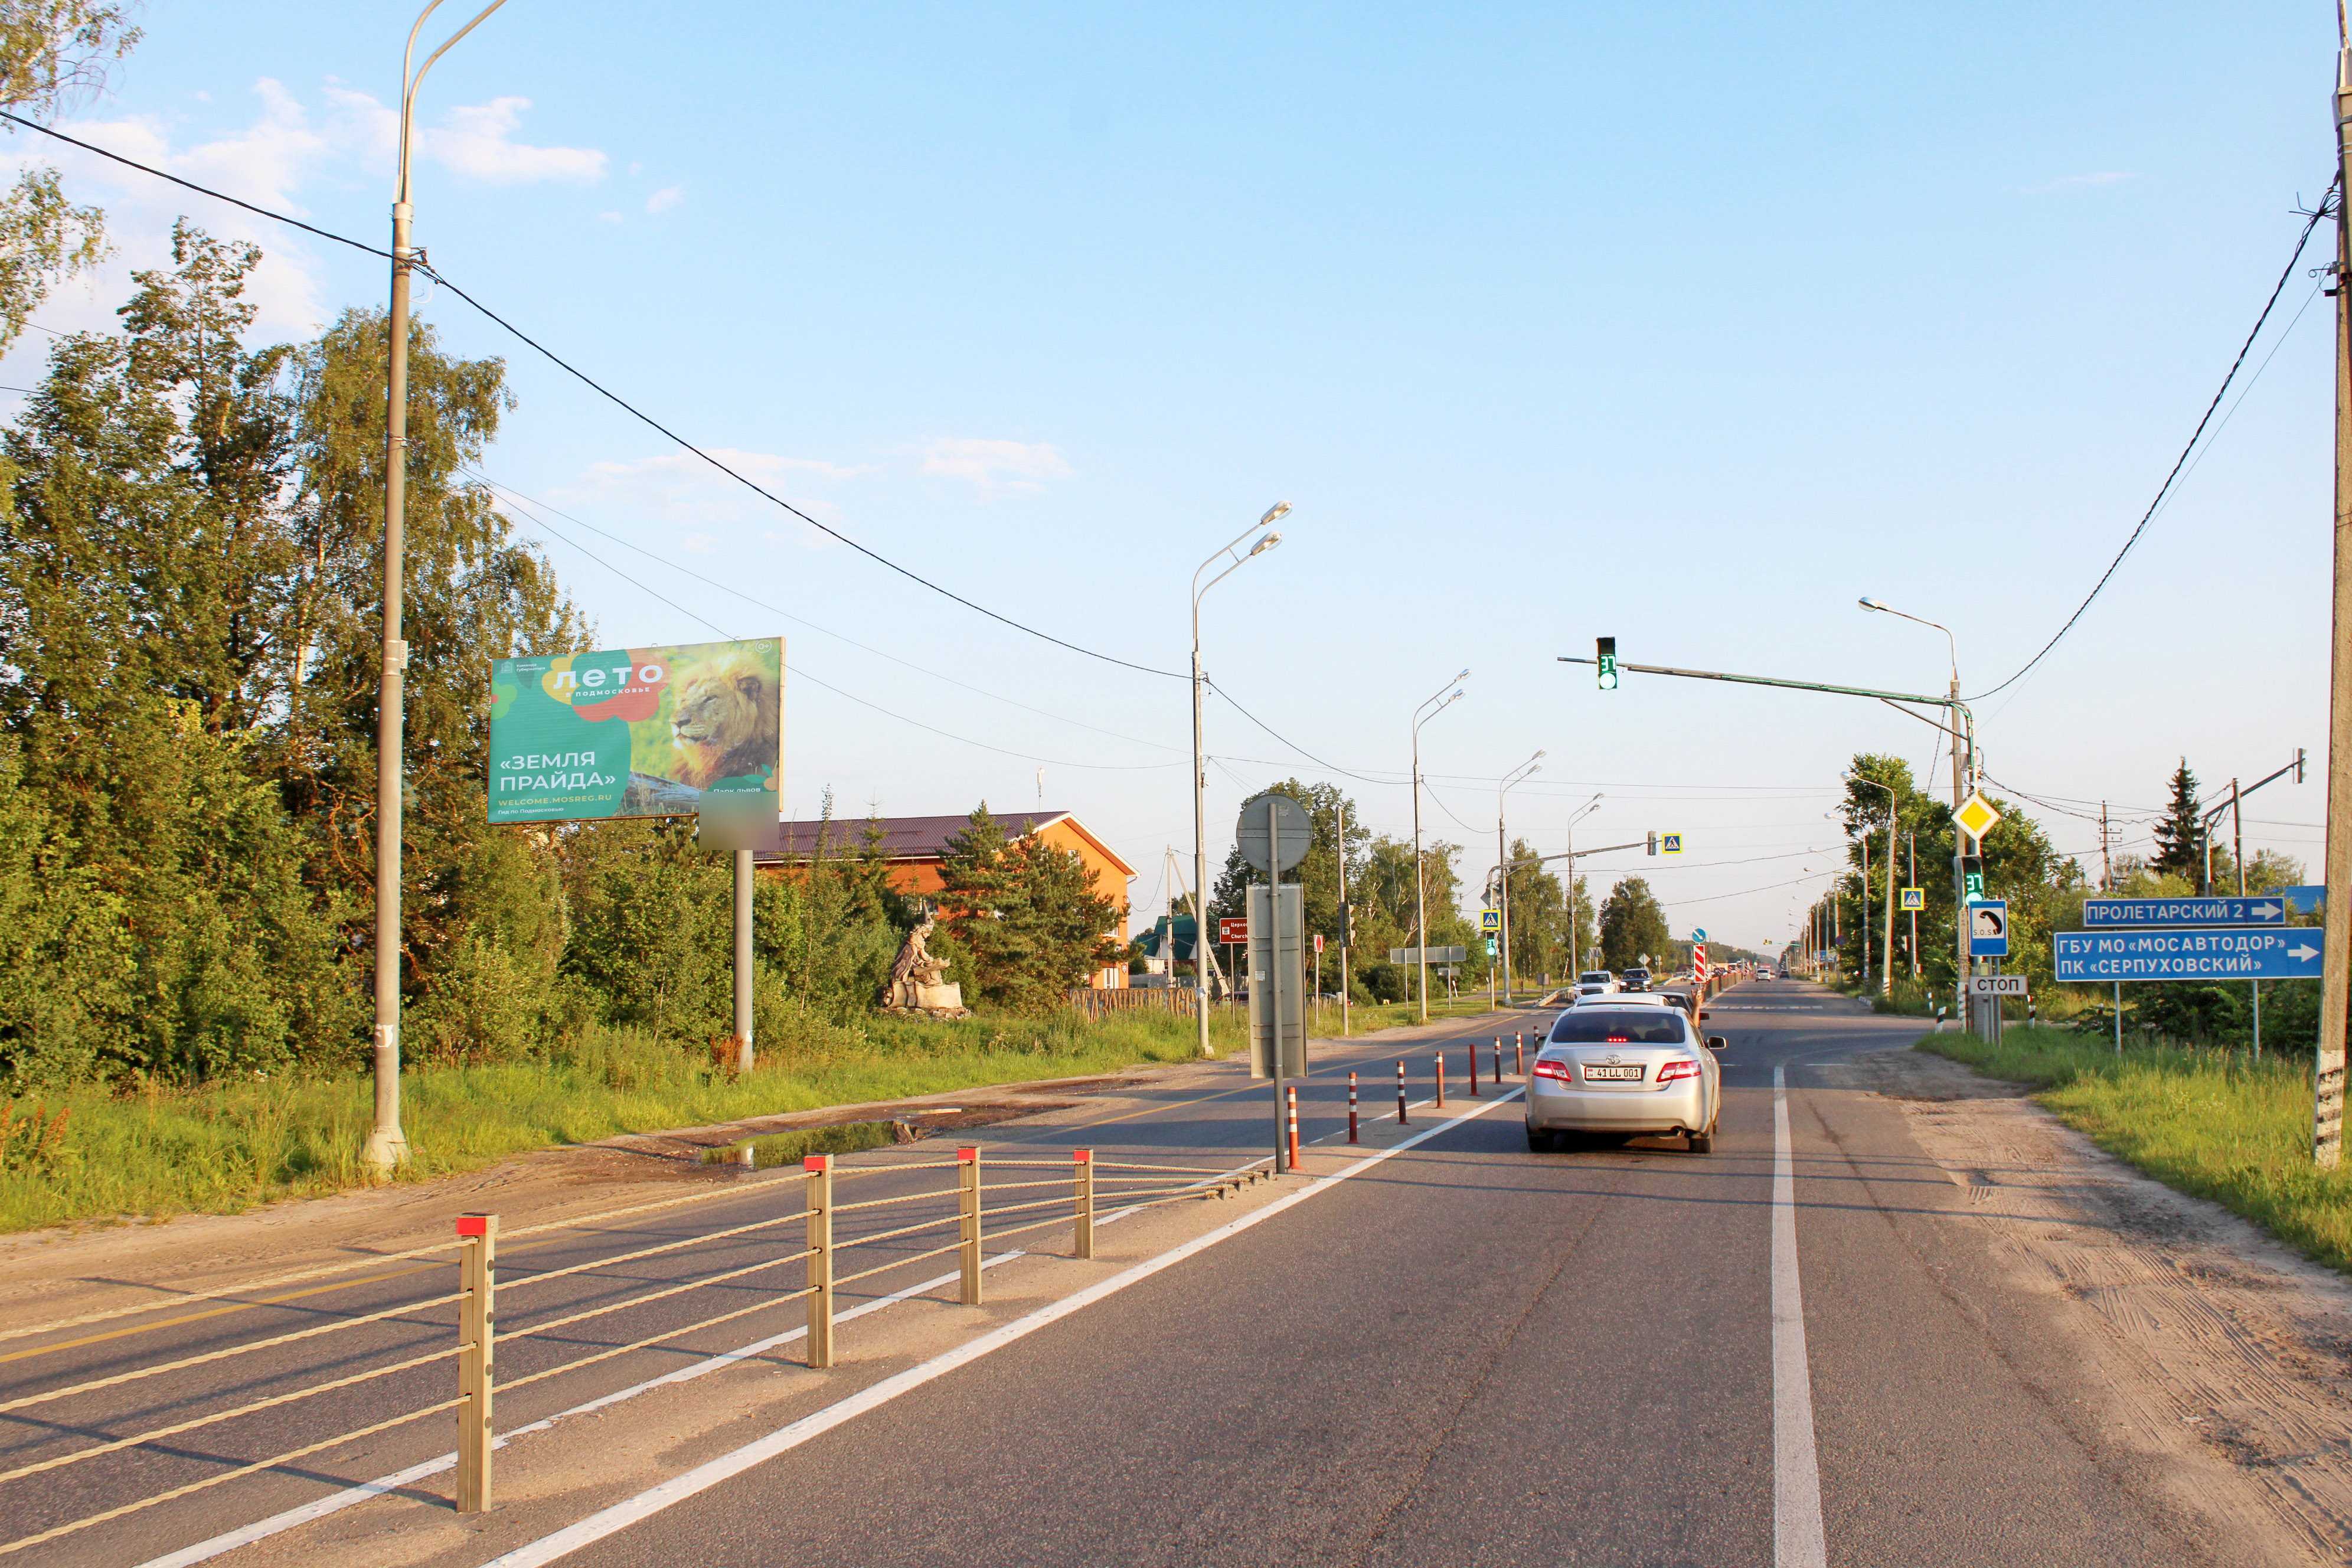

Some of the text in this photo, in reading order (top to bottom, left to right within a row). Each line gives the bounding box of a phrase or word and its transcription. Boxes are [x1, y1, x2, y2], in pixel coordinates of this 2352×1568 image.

[1600, 655, 1616, 671] 37
[500, 751, 596, 770] «ЗЕМЛЯ
[500, 770, 616, 792] ПРАЙДА»
[498, 795, 612, 806] WELCOME.MOSREG.RU
[1966, 874, 1982, 891] 37
[2088, 900, 2243, 920] ПРОЛЕТАРСКИЙ 2
[2059, 936, 2286, 954] ГБУ МО «МОСАВТОДОР»
[2061, 953, 2262, 974] ПК «СЕРПУХОВСКИЙ»
[1977, 979, 2019, 991] СТОП
[1597, 1069, 1607, 1077] 41
[1609, 1069, 1621, 1077] LL
[1623, 1069, 1639, 1077] 001
